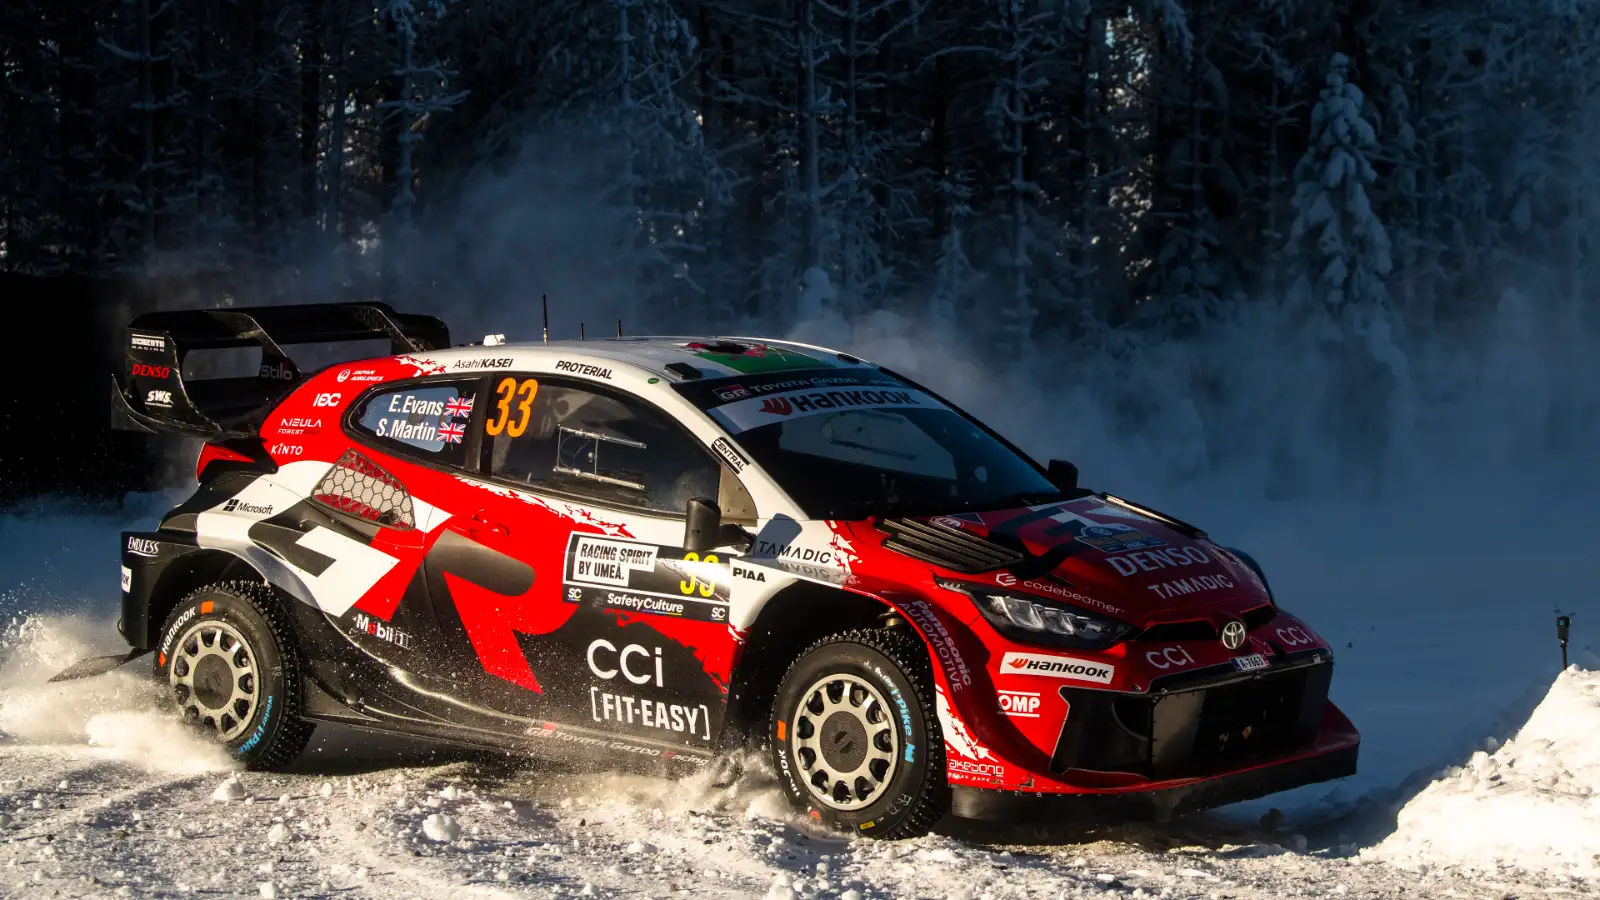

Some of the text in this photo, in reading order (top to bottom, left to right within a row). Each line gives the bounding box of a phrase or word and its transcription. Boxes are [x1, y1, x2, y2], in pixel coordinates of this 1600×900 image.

[131, 345, 165, 353] RACING
[131, 363, 170, 379] DENSO
[260, 362, 293, 380] Stilo
[453, 358, 514, 369] AsahiKASEI
[555, 359, 613, 380] PROTERIAL
[718, 387, 750, 402] GR
[749, 378, 811, 394] TOYOTA
[388, 393, 444, 416] E.Evans
[485, 376, 540, 438] 33
[277, 428, 304, 436] FOREST
[375, 418, 436, 442] S.Martin
[712, 437, 745, 472] CENTRAL
[236, 501, 273, 515] Microsoft
[127, 536, 160, 556] ENDLESS
[580, 543, 653, 566] RACING SPIRIT
[759, 540, 832, 564] TAMADIC
[578, 560, 592, 576] BY
[1104, 545, 1211, 577] DENSO
[732, 567, 766, 583] PIAA
[567, 588, 582, 600] SC
[1023, 579, 1124, 615] codebeamer
[1146, 573, 1234, 600] TAMADIC
[607, 592, 684, 614] SafetyCulture
[711, 606, 726, 620] SC
[356, 613, 394, 642] Mobil
[897, 602, 964, 693] AUTOMOTIVE
[910, 598, 972, 687] Panasonic
[998, 694, 1041, 713] OMP
